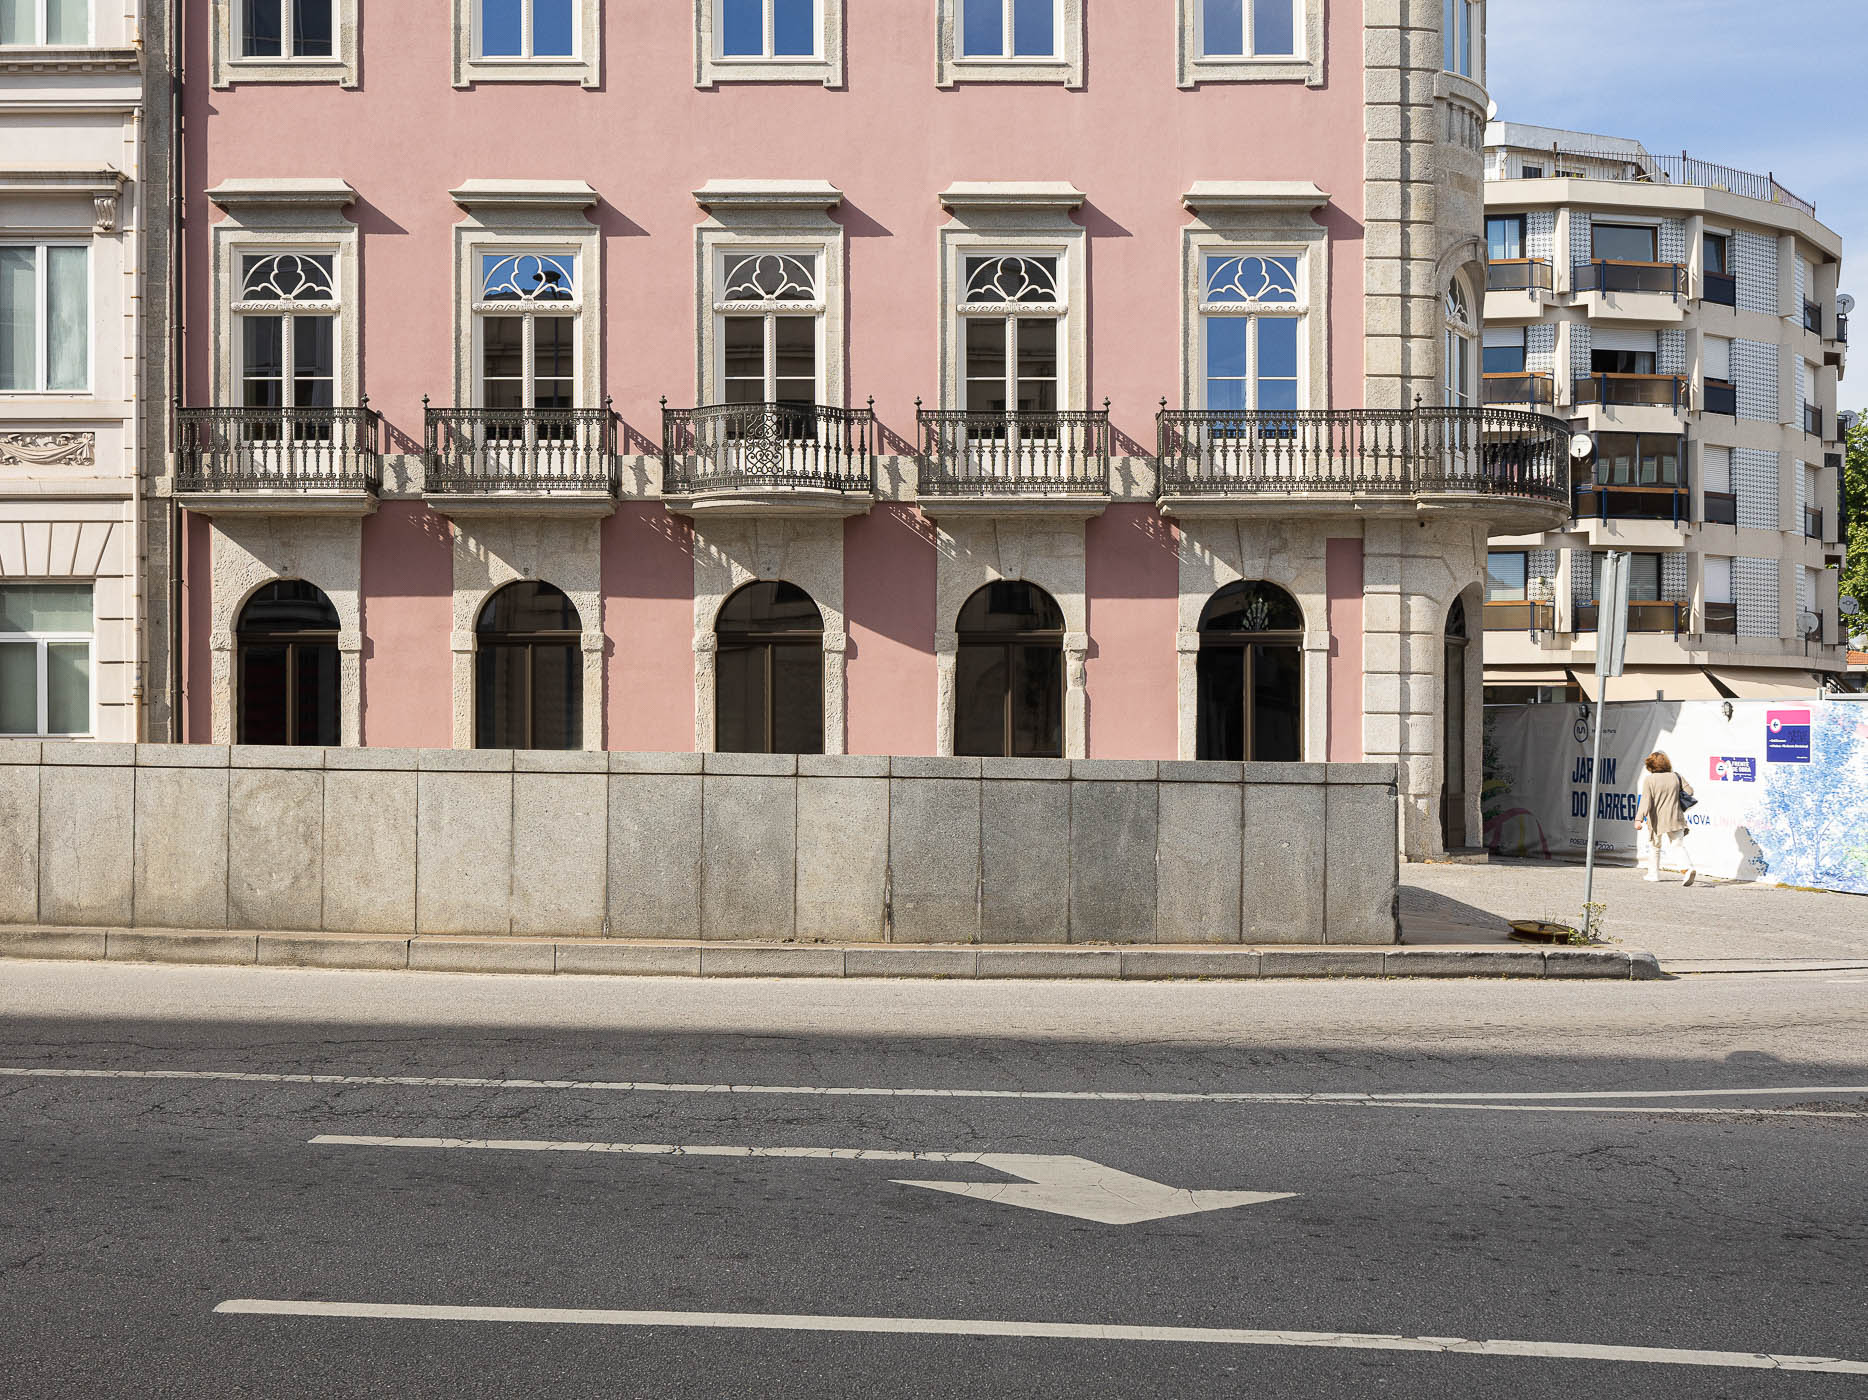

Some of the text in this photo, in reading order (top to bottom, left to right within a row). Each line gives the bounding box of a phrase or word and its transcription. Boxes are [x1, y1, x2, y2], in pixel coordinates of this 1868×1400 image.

[1572, 757, 1617, 784] JARIM
[1571, 791, 1647, 821] DO ARREG
[1686, 814, 1711, 825] NOVA
